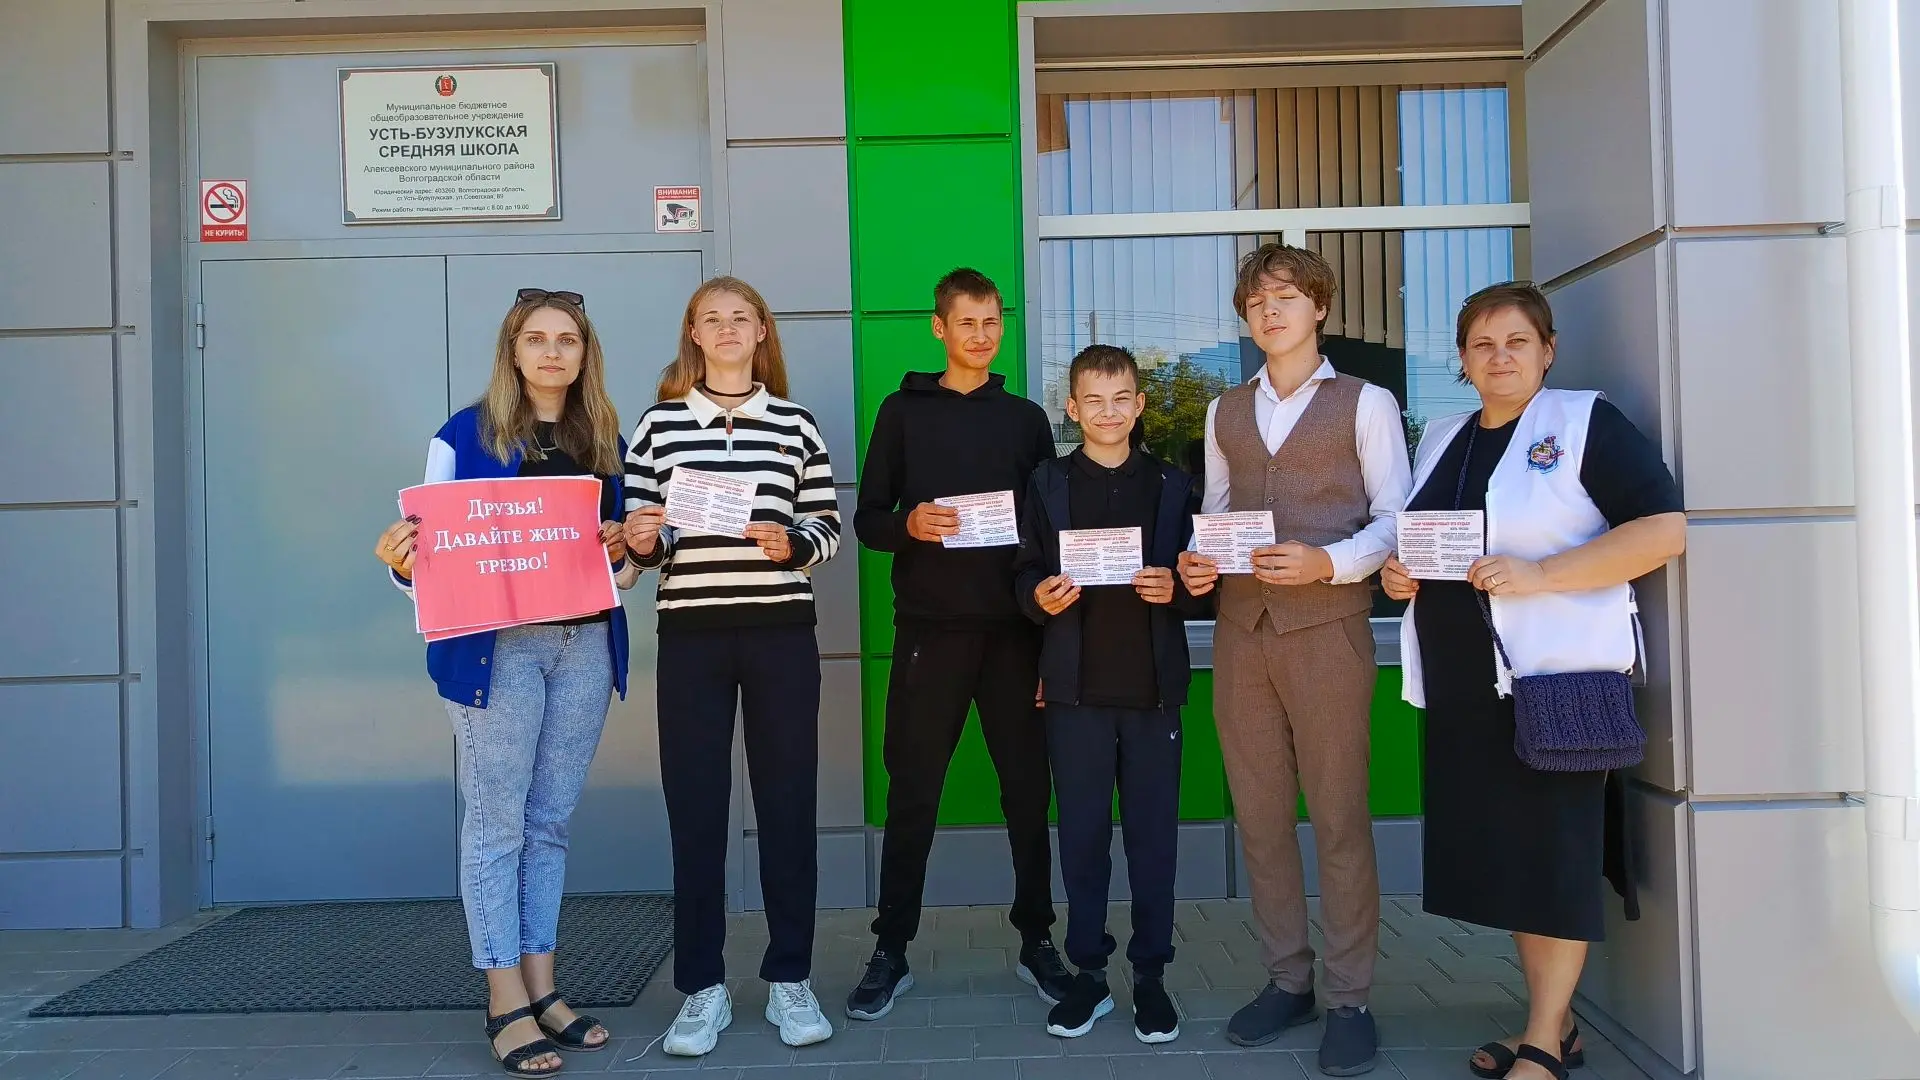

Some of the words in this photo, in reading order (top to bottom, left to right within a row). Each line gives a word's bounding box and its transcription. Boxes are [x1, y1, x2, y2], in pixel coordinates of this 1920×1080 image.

[387, 102, 456, 112] Муниципальное
[459, 101, 507, 111] бюджетное
[371, 113, 469, 123] общеобразовательное
[472, 112, 523, 121] учреждение
[369, 125, 527, 141] УСТЬ-БУЗУЛУКСКАЯ
[379, 144, 455, 159] СРЕДНЯЯ
[461, 143, 519, 156] ШКОЛА
[364, 164, 427, 174] Алексеевского
[430, 163, 501, 173] муниципального
[504, 161, 535, 171] района
[399, 174, 463, 184] Волгоградской
[465, 173, 500, 181] области
[657, 188, 698, 196] ВНИМАНИЕ
[204, 229, 215, 237] НЕ
[215, 229, 245, 237] КУРИТЬ!
